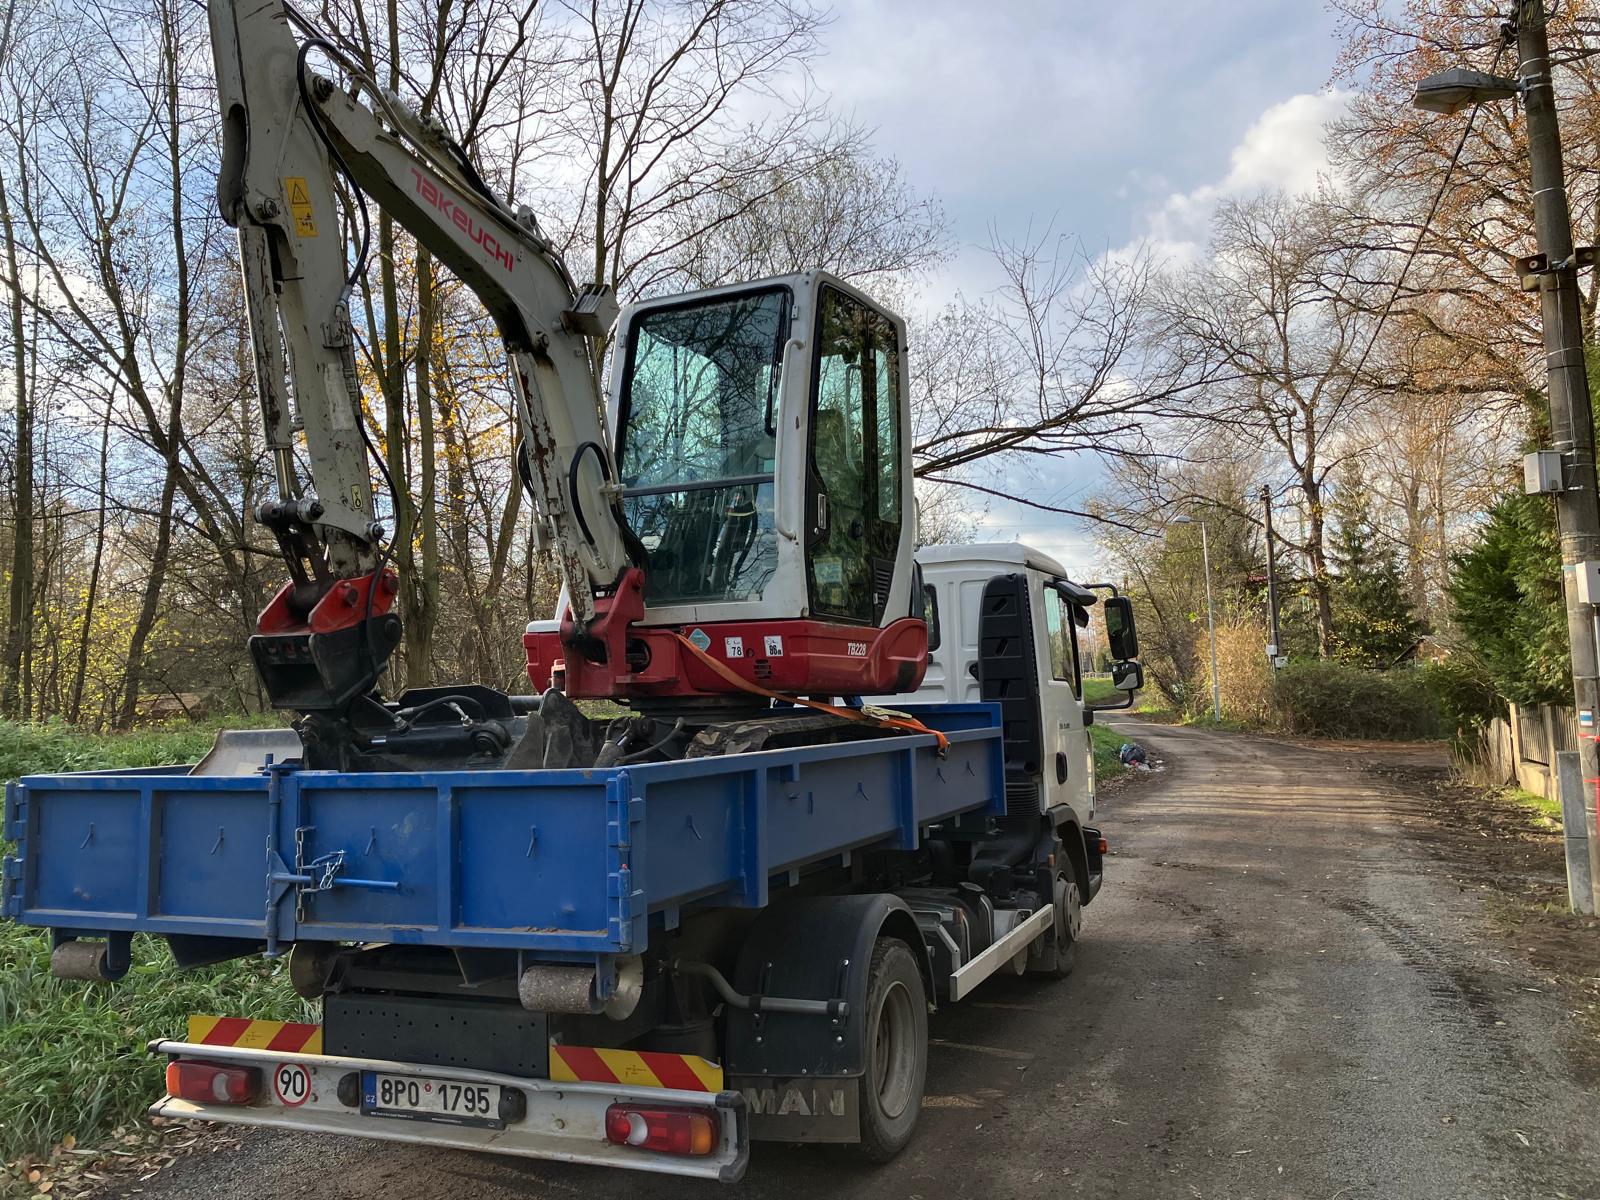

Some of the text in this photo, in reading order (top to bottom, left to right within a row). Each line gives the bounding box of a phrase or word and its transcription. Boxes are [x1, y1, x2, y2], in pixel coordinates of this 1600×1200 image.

[847, 642, 867, 656] TB228
[280, 1069, 305, 1097] 90
[365, 1094, 376, 1103] CZ
[438, 1084, 490, 1114] 1795
[742, 1087, 845, 1116] MAN
